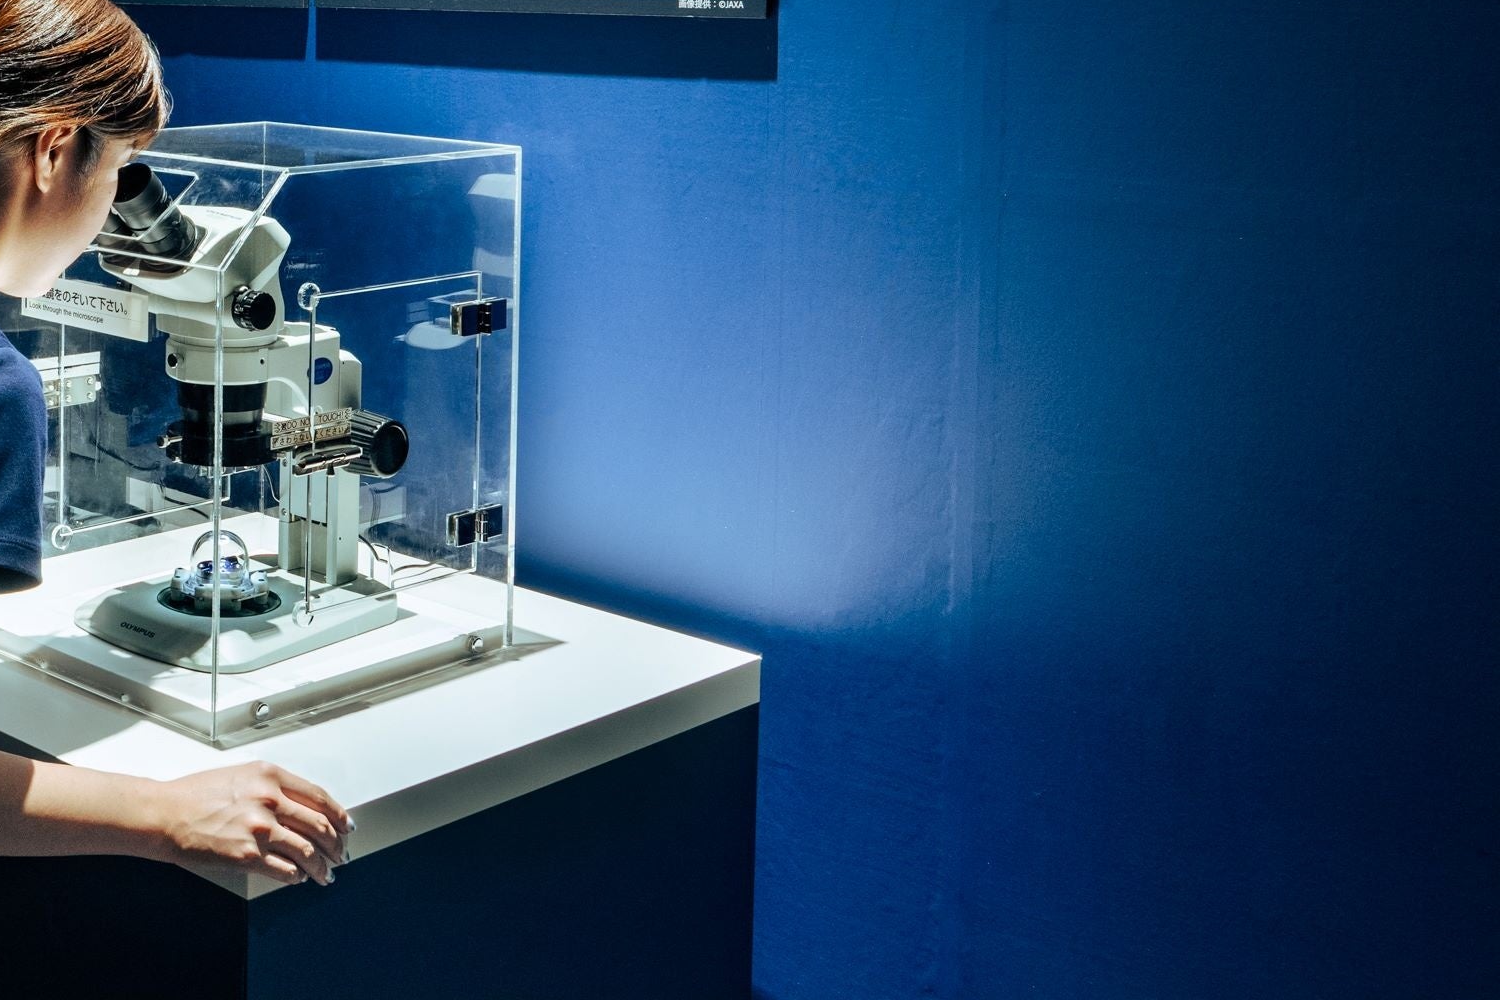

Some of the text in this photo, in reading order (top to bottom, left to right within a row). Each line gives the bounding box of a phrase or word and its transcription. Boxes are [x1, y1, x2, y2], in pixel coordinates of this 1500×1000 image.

[29, 301, 104, 324] Look through the microscope
[120, 621, 156, 638] OLYMPUS
